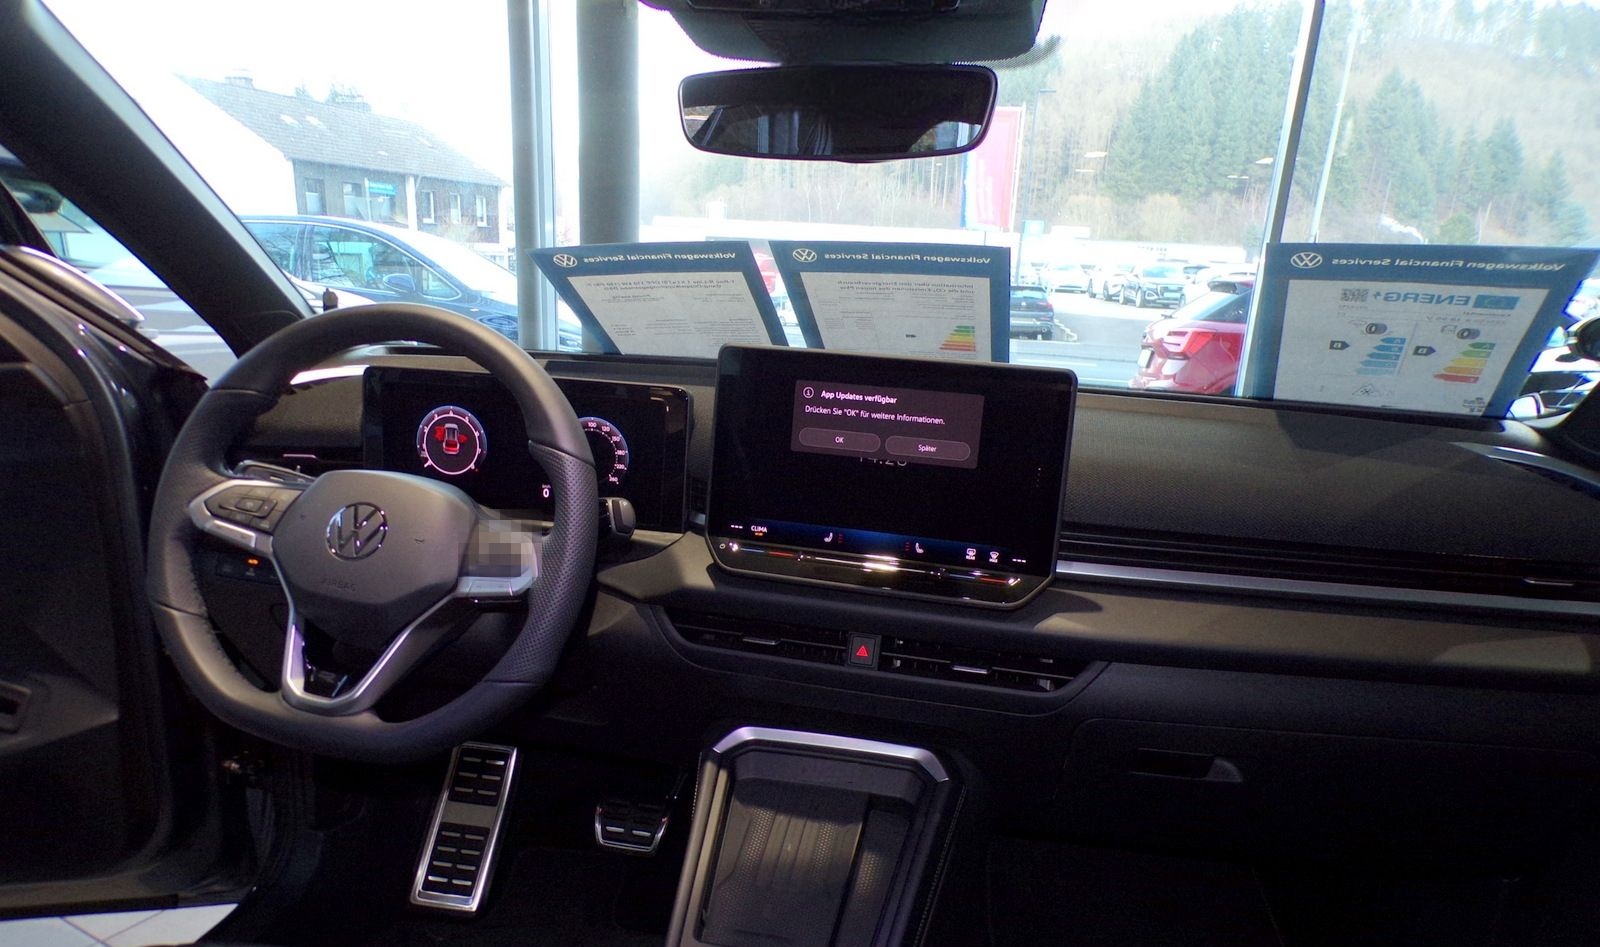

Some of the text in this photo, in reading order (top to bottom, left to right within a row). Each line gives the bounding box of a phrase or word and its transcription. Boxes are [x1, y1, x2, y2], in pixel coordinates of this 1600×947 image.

[821, 390, 897, 404] App Updates verfügbar
[805, 405, 831, 415] Drücken
[832, 407, 842, 415] Sie
[860, 410, 869, 418] für
[871, 411, 895, 421] weitere
[896, 413, 945, 425] Informationen.
[835, 436, 844, 444] OK
[918, 444, 937, 453] Später
[543, 488, 550, 498] 0
[751, 525, 768, 533] CLIMA
